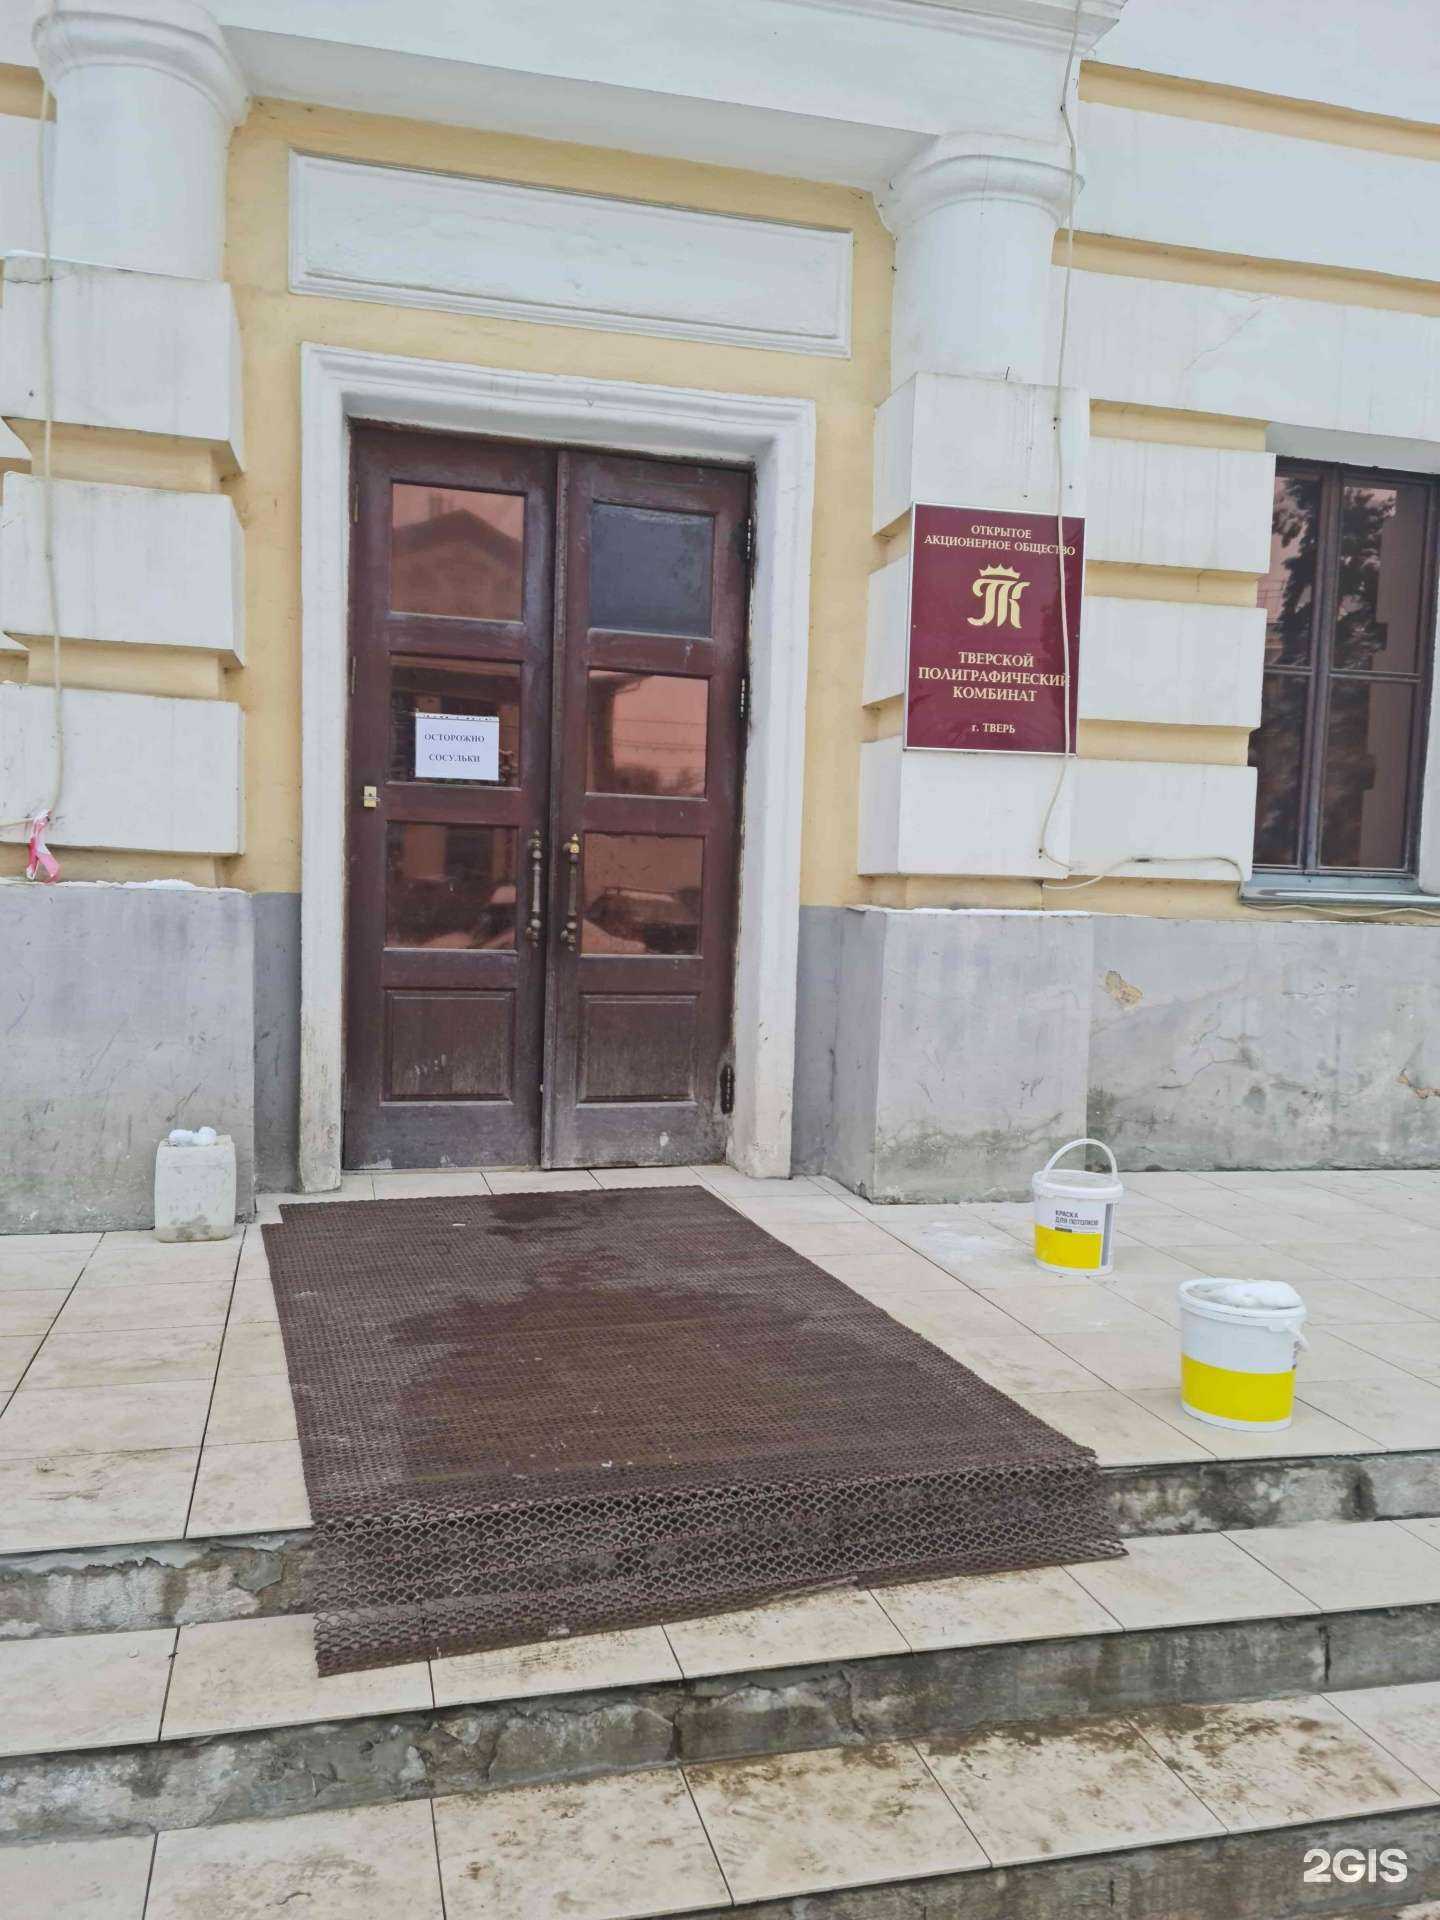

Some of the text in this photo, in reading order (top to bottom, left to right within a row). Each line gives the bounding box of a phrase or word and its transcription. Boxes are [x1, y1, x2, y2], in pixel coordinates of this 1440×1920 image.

[971, 525, 1032, 539] ОТКРЫТОЕ
[924, 534, 1076, 556] АКЦИОНЕРНОЕ ОБЩЕСТВО
[958, 651, 1034, 668] ТВЕРСКОЙ
[953, 686, 1037, 702] КОМБИНАТ
[971, 722, 1016, 734] г. ТВЕРЬ
[424, 733, 485, 743] ОСТОРОЖНО
[428, 753, 480, 763] СОСУЛЬКИ
[1055, 1210, 1079, 1218] КРАСКА
